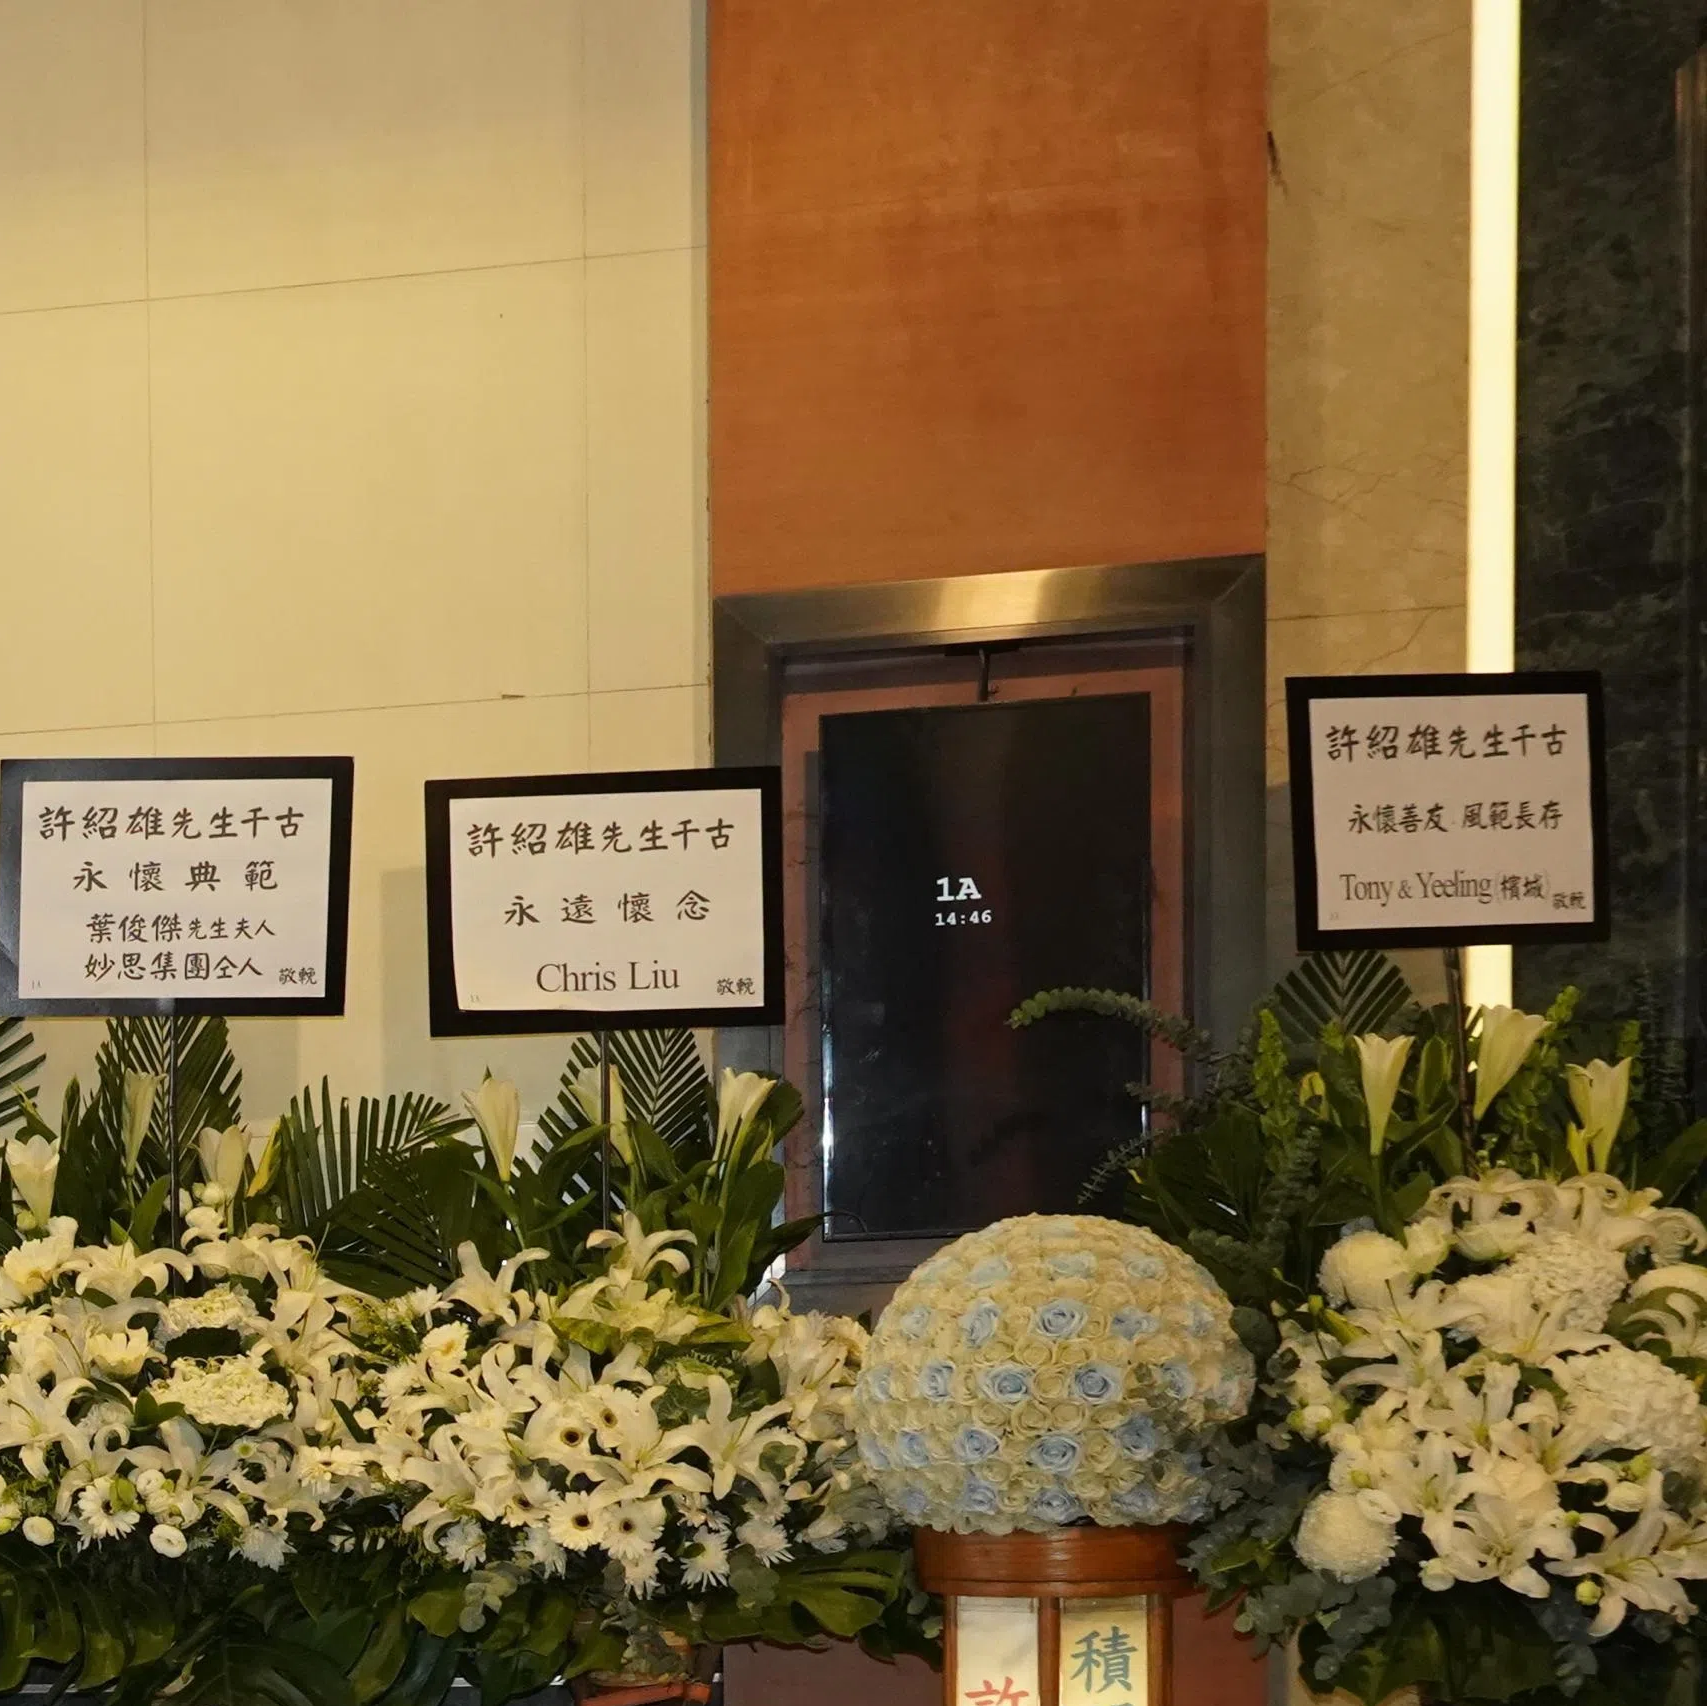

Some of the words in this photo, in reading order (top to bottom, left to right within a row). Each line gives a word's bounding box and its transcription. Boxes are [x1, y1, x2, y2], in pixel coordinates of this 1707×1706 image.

[1326, 724, 1567, 762] 許紹雄先生千古
[39, 806, 304, 841] 許紹雄先生千古
[1349, 803, 1448, 834] 永懷善友
[1463, 800, 1563, 830] 風範長存
[467, 818, 734, 858] 許紹雄先生千古
[73, 860, 278, 892] 永懷典範
[936, 876, 982, 902] 1A
[1340, 874, 1393, 907] Tony
[1398, 880, 1412, 899] &
[1416, 870, 1492, 904] Yeeling
[505, 890, 710, 926] 永遠懷念
[934, 910, 993, 926] 14:46
[279, 967, 317, 984] 敬輓
[537, 962, 616, 992] Chris
[629, 960, 679, 989] Liu
[717, 978, 755, 995] 敬輓
